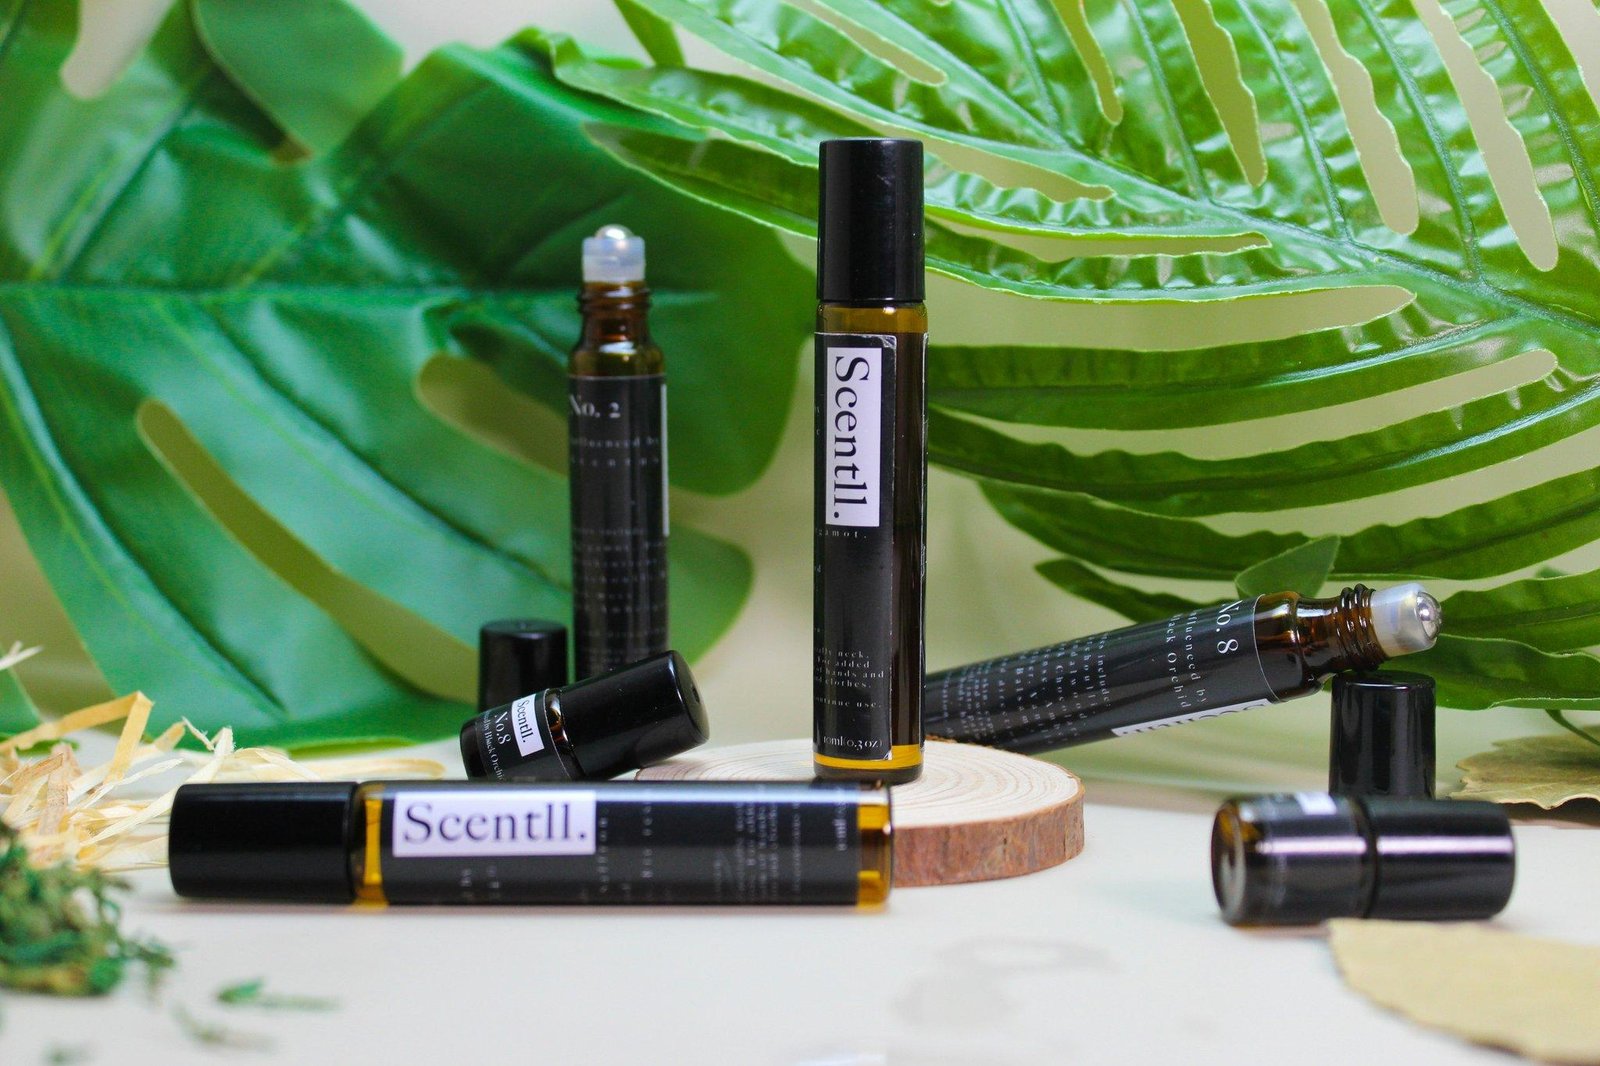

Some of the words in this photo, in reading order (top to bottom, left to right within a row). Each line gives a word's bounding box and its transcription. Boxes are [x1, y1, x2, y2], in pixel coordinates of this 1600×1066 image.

[609, 402, 621, 418] 2
[833, 356, 870, 519] Scentll.
[1217, 639, 1239, 654] 8
[835, 660, 870, 668] added
[863, 671, 884, 679] and
[1167, 652, 1192, 708] Orchid
[516, 700, 534, 743] Scentll.
[403, 802, 588, 844] Scentll.
